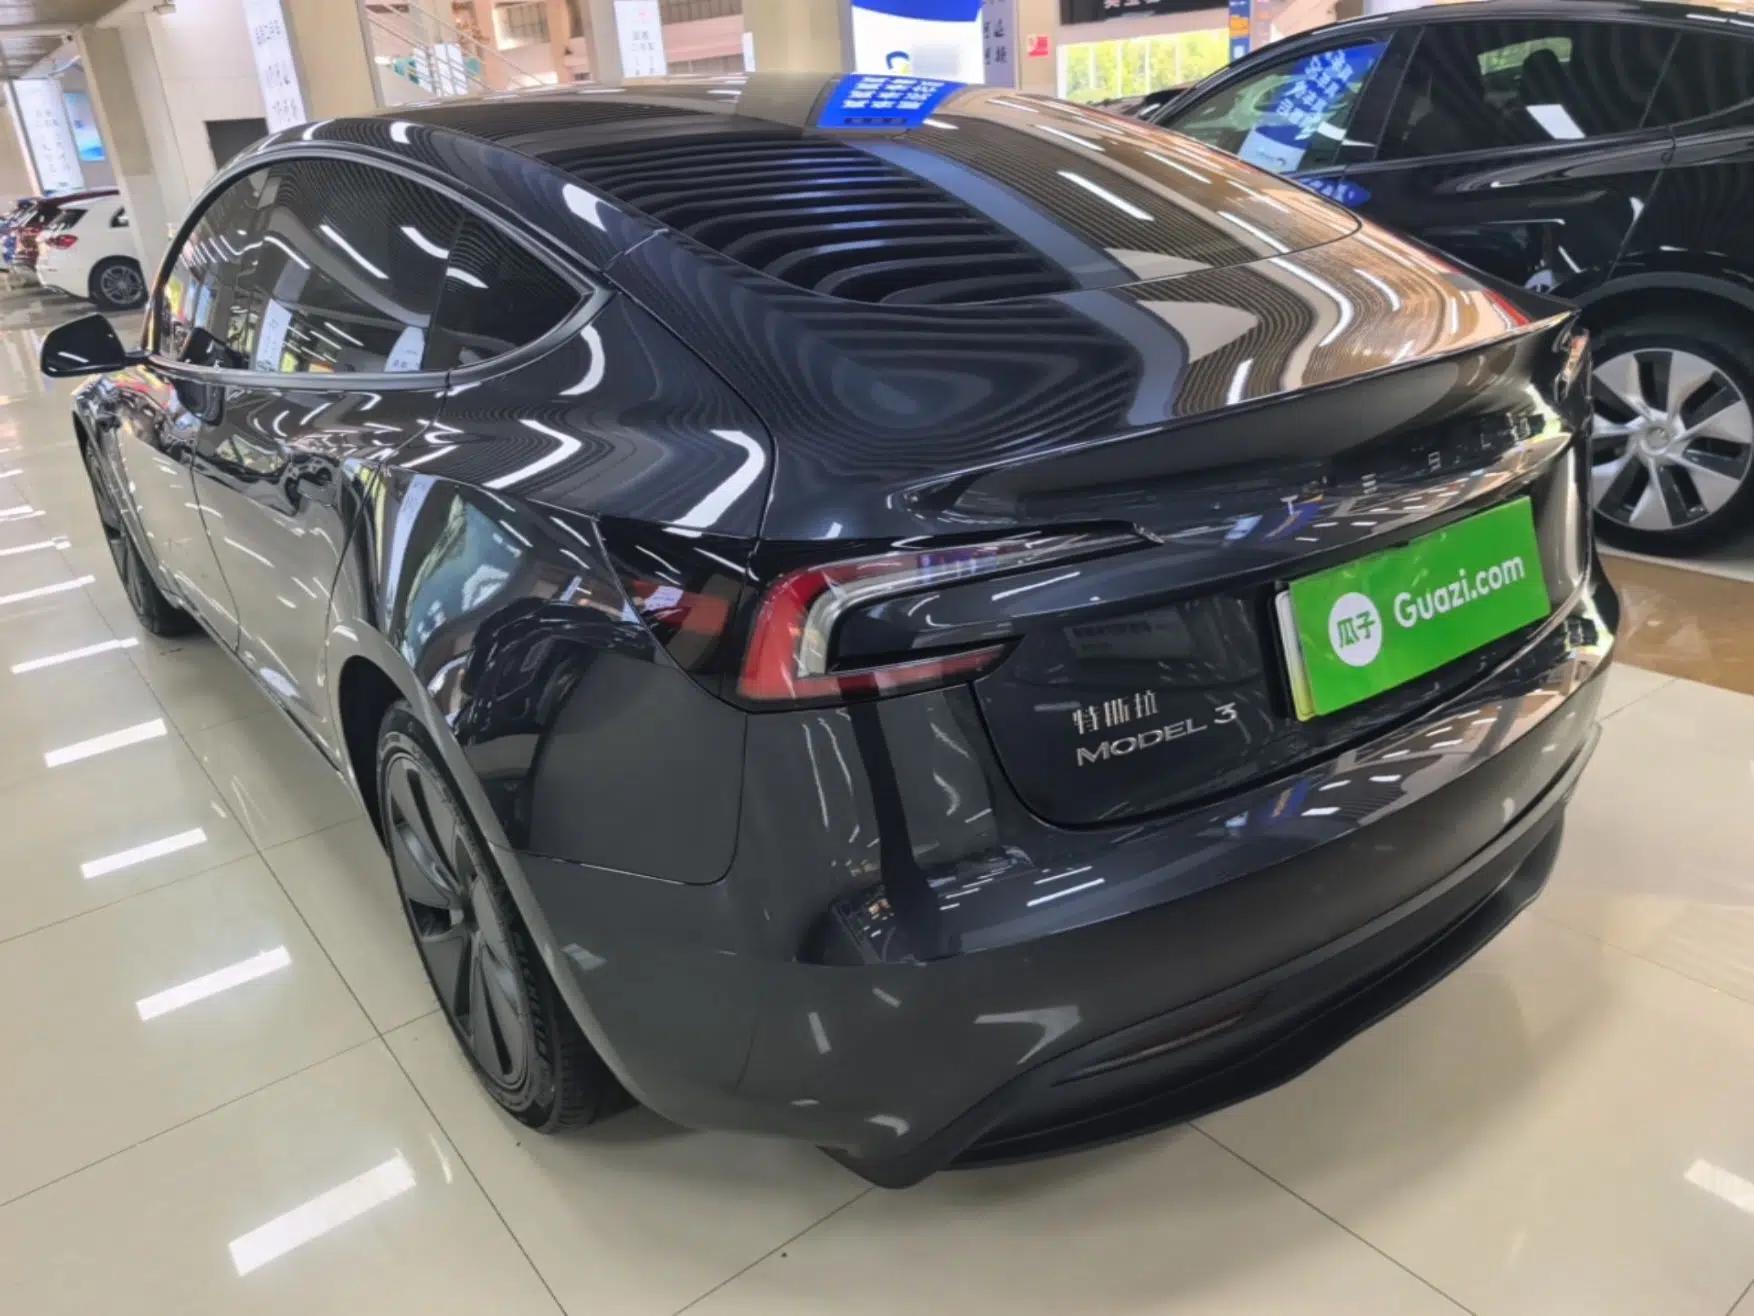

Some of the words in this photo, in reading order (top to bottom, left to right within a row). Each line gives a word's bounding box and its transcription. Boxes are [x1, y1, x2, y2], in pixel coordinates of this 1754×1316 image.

[1393, 556, 1526, 628] Guazi.com
[1336, 611, 1376, 648] 瓜子
[1072, 690, 1158, 735] 特斯拉
[1076, 718, 1208, 767] MODEL
[1214, 702, 1237, 724] 3
